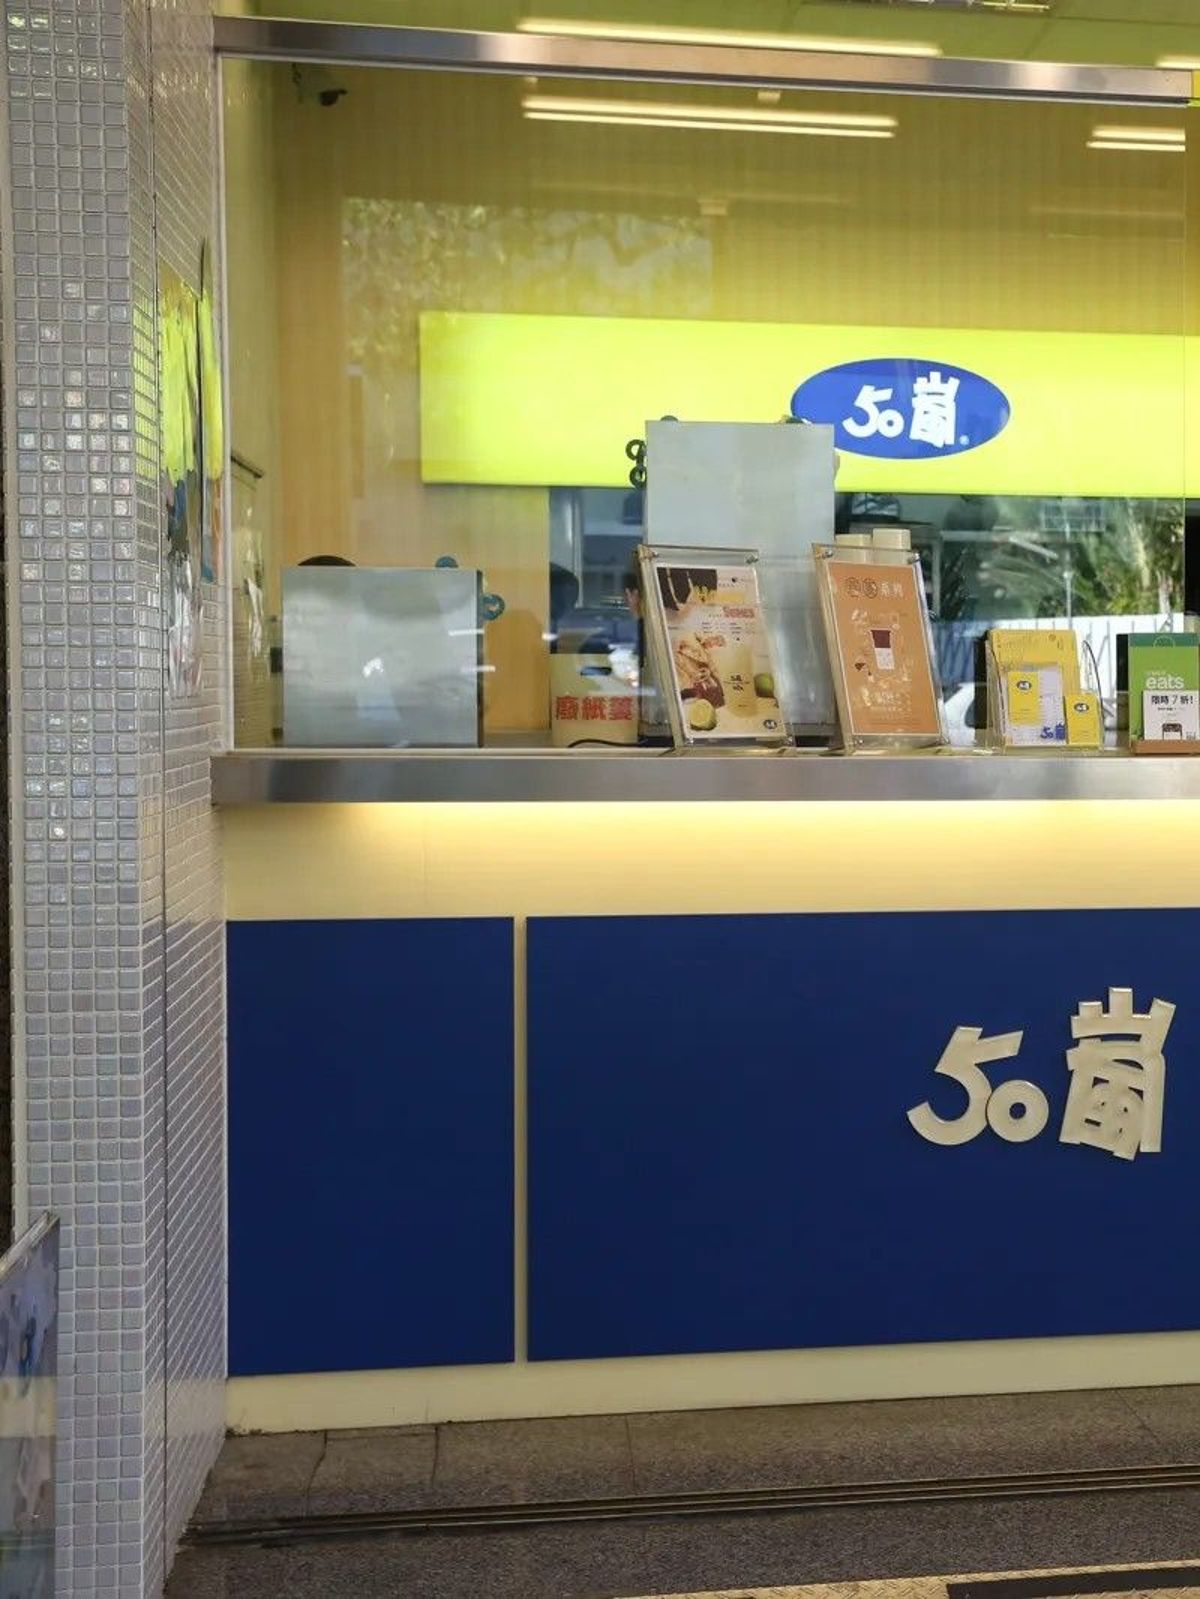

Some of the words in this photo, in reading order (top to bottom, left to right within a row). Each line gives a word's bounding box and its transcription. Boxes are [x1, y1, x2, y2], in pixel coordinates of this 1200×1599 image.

[842, 371, 960, 448] 50嵐
[1145, 674, 1184, 689] eats
[907, 987, 1176, 1161] 50嵐
